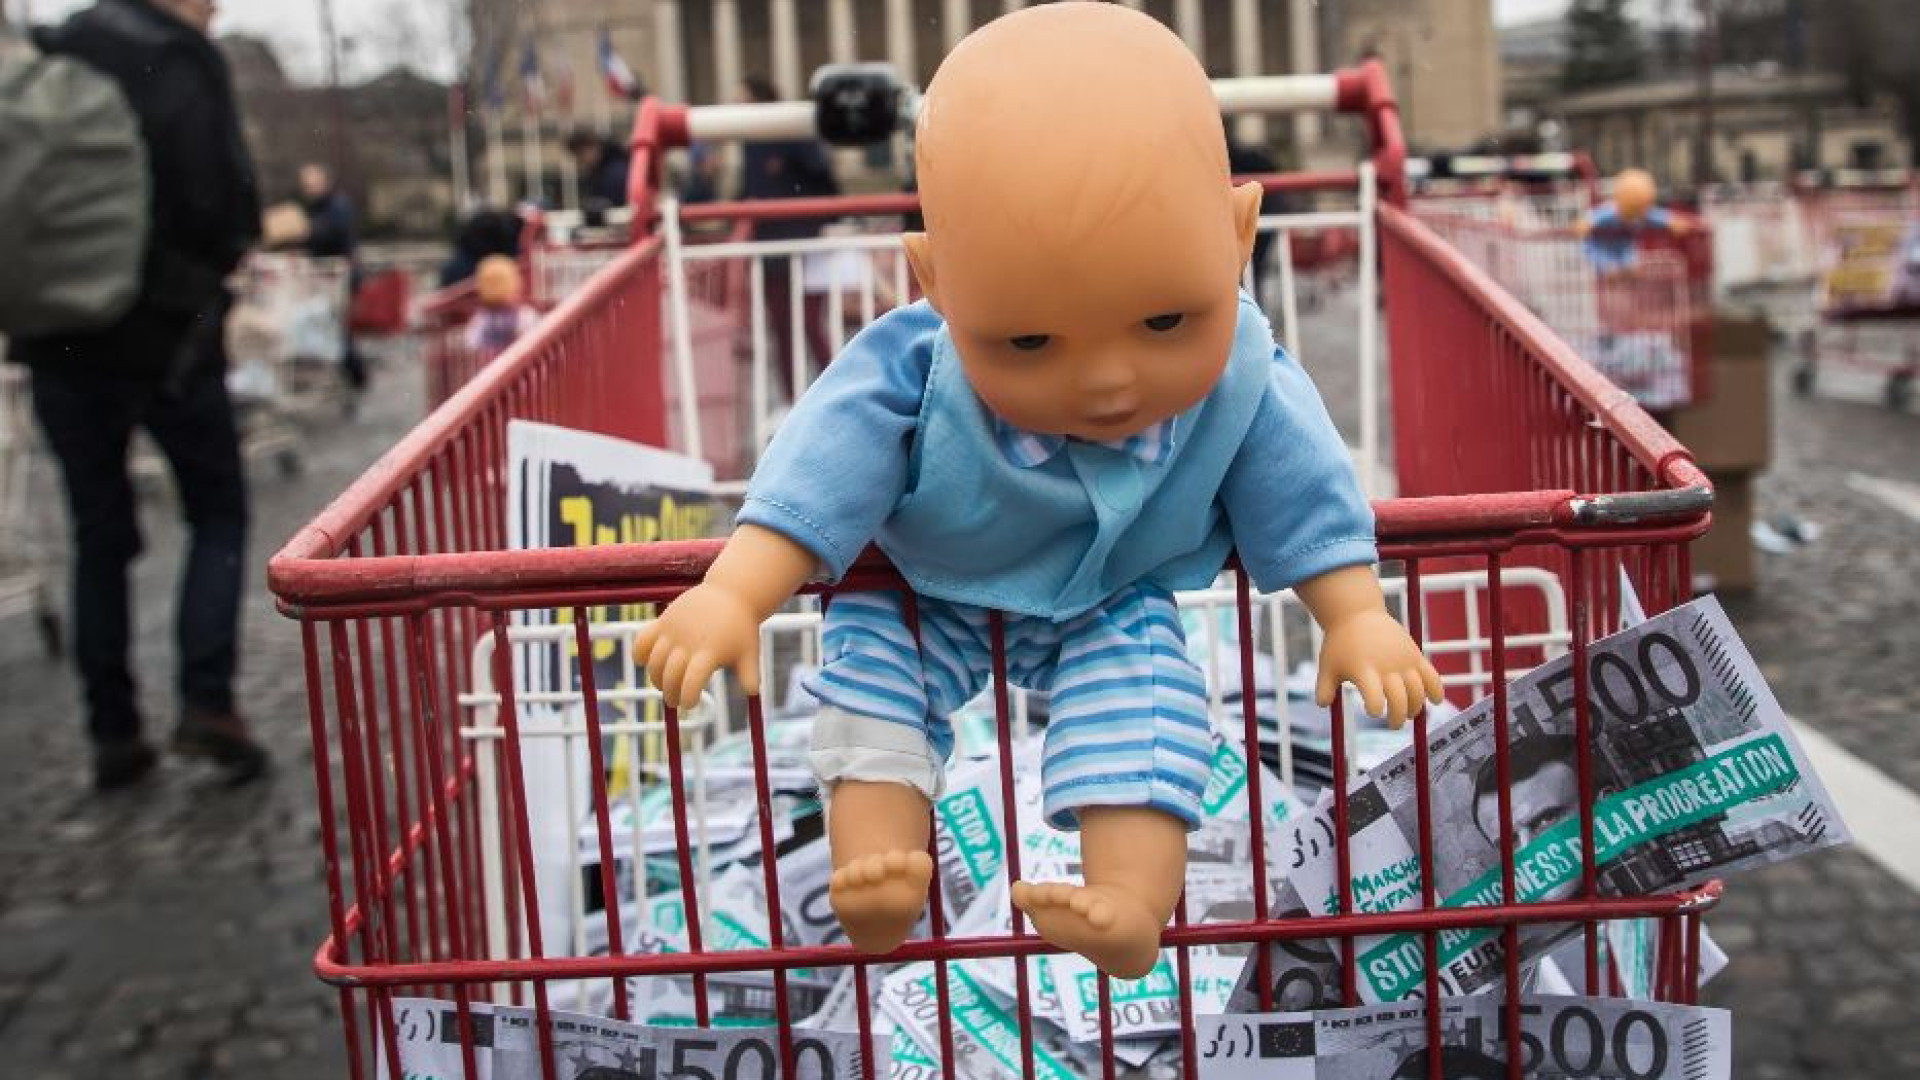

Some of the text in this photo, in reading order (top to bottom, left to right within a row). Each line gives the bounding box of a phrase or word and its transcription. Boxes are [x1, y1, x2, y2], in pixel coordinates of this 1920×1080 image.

[1536, 632, 1701, 744] 500
[1360, 876, 1421, 914] ENFAN
[1369, 941, 1424, 991] STO
[1595, 811, 1635, 846] LA
[1448, 935, 1505, 980] EUR
[1498, 1005, 1668, 1079] 500
